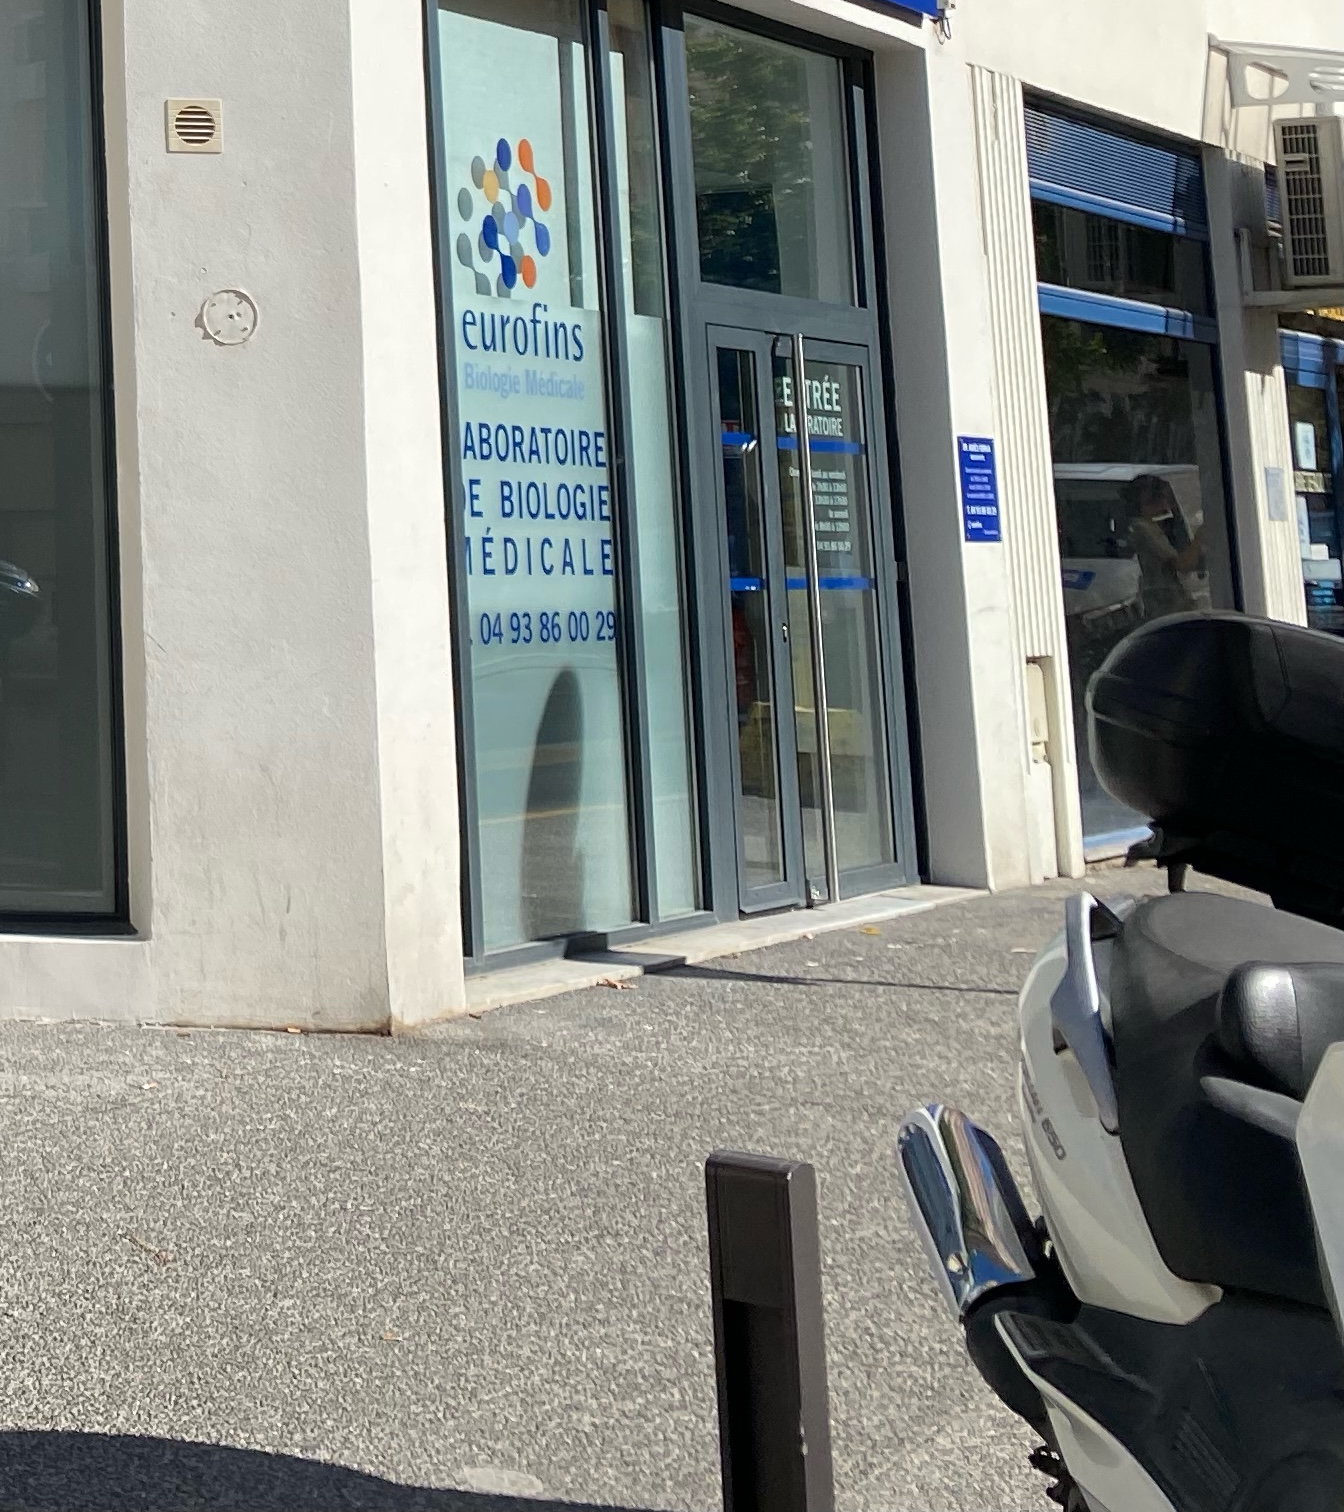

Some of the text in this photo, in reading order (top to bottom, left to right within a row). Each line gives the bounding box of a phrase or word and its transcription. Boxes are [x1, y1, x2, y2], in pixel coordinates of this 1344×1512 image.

[462, 302, 584, 362] eurofins
[464, 362, 585, 400] Biologie Médicale
[782, 374, 842, 413] ETRÉE
[462, 421, 608, 468] ABORATOIRE
[784, 413, 844, 437] LARATOIRE
[463, 478, 612, 522] E BIOLOGIE
[480, 610, 616, 645] 04 93 86 00 29
